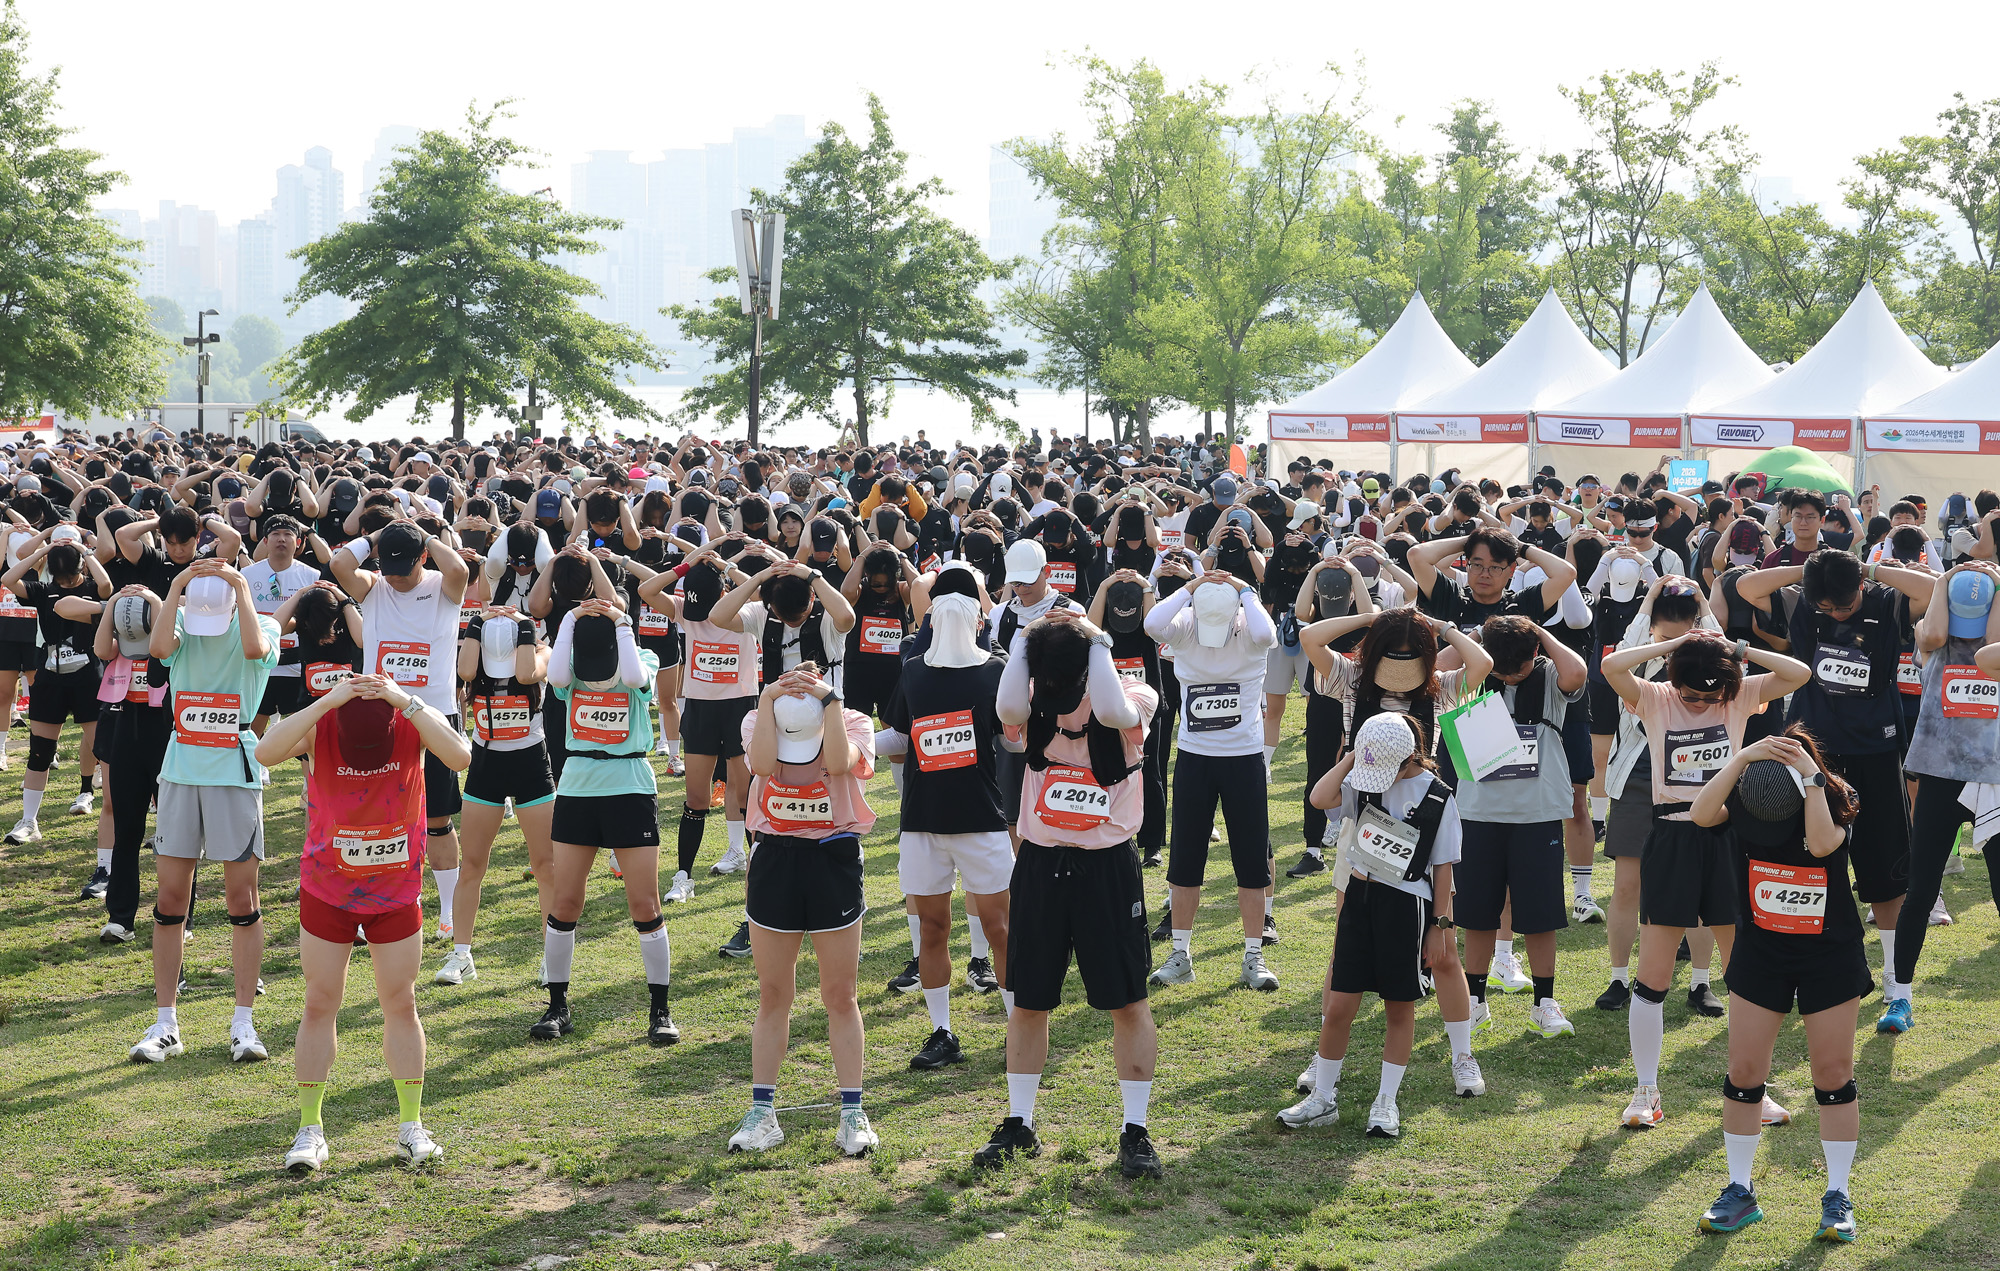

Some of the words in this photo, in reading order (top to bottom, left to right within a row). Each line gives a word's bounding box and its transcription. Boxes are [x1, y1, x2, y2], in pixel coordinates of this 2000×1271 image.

[1564, 426, 1598, 436] FAVONEX
[1720, 429, 1757, 438] FAVONEX
[1798, 430, 1830, 438] BURNING
[1830, 430, 1846, 438] RUN
[1681, 468, 1696, 476] 2026
[397, 657, 427, 668] 2186
[708, 657, 737, 665] 2549
[1836, 664, 1867, 679] 7048
[1950, 685, 1959, 694] M
[1964, 684, 1997, 696] 1809
[1206, 698, 1238, 710] 7305
[200, 712, 238, 724] 1982
[494, 712, 527, 720] 4575
[591, 711, 627, 722] 4097
[925, 739, 932, 747] M
[937, 730, 972, 745] 1709
[1677, 754, 1688, 763] W
[1693, 745, 1729, 762] 7607
[1051, 790, 1062, 799] M
[1064, 789, 1107, 806] 2014
[787, 803, 828, 813] 4118
[1366, 808, 1384, 823] BURNING
[1383, 816, 1396, 827] RUN
[1406, 830, 1416, 838] 5km
[365, 840, 406, 856] 1337
[1362, 829, 1372, 840] W
[1371, 834, 1413, 860] 5752
[1752, 865, 1780, 875] BURNING
[1761, 889, 1772, 900] W
[1776, 890, 1824, 905] 4257
